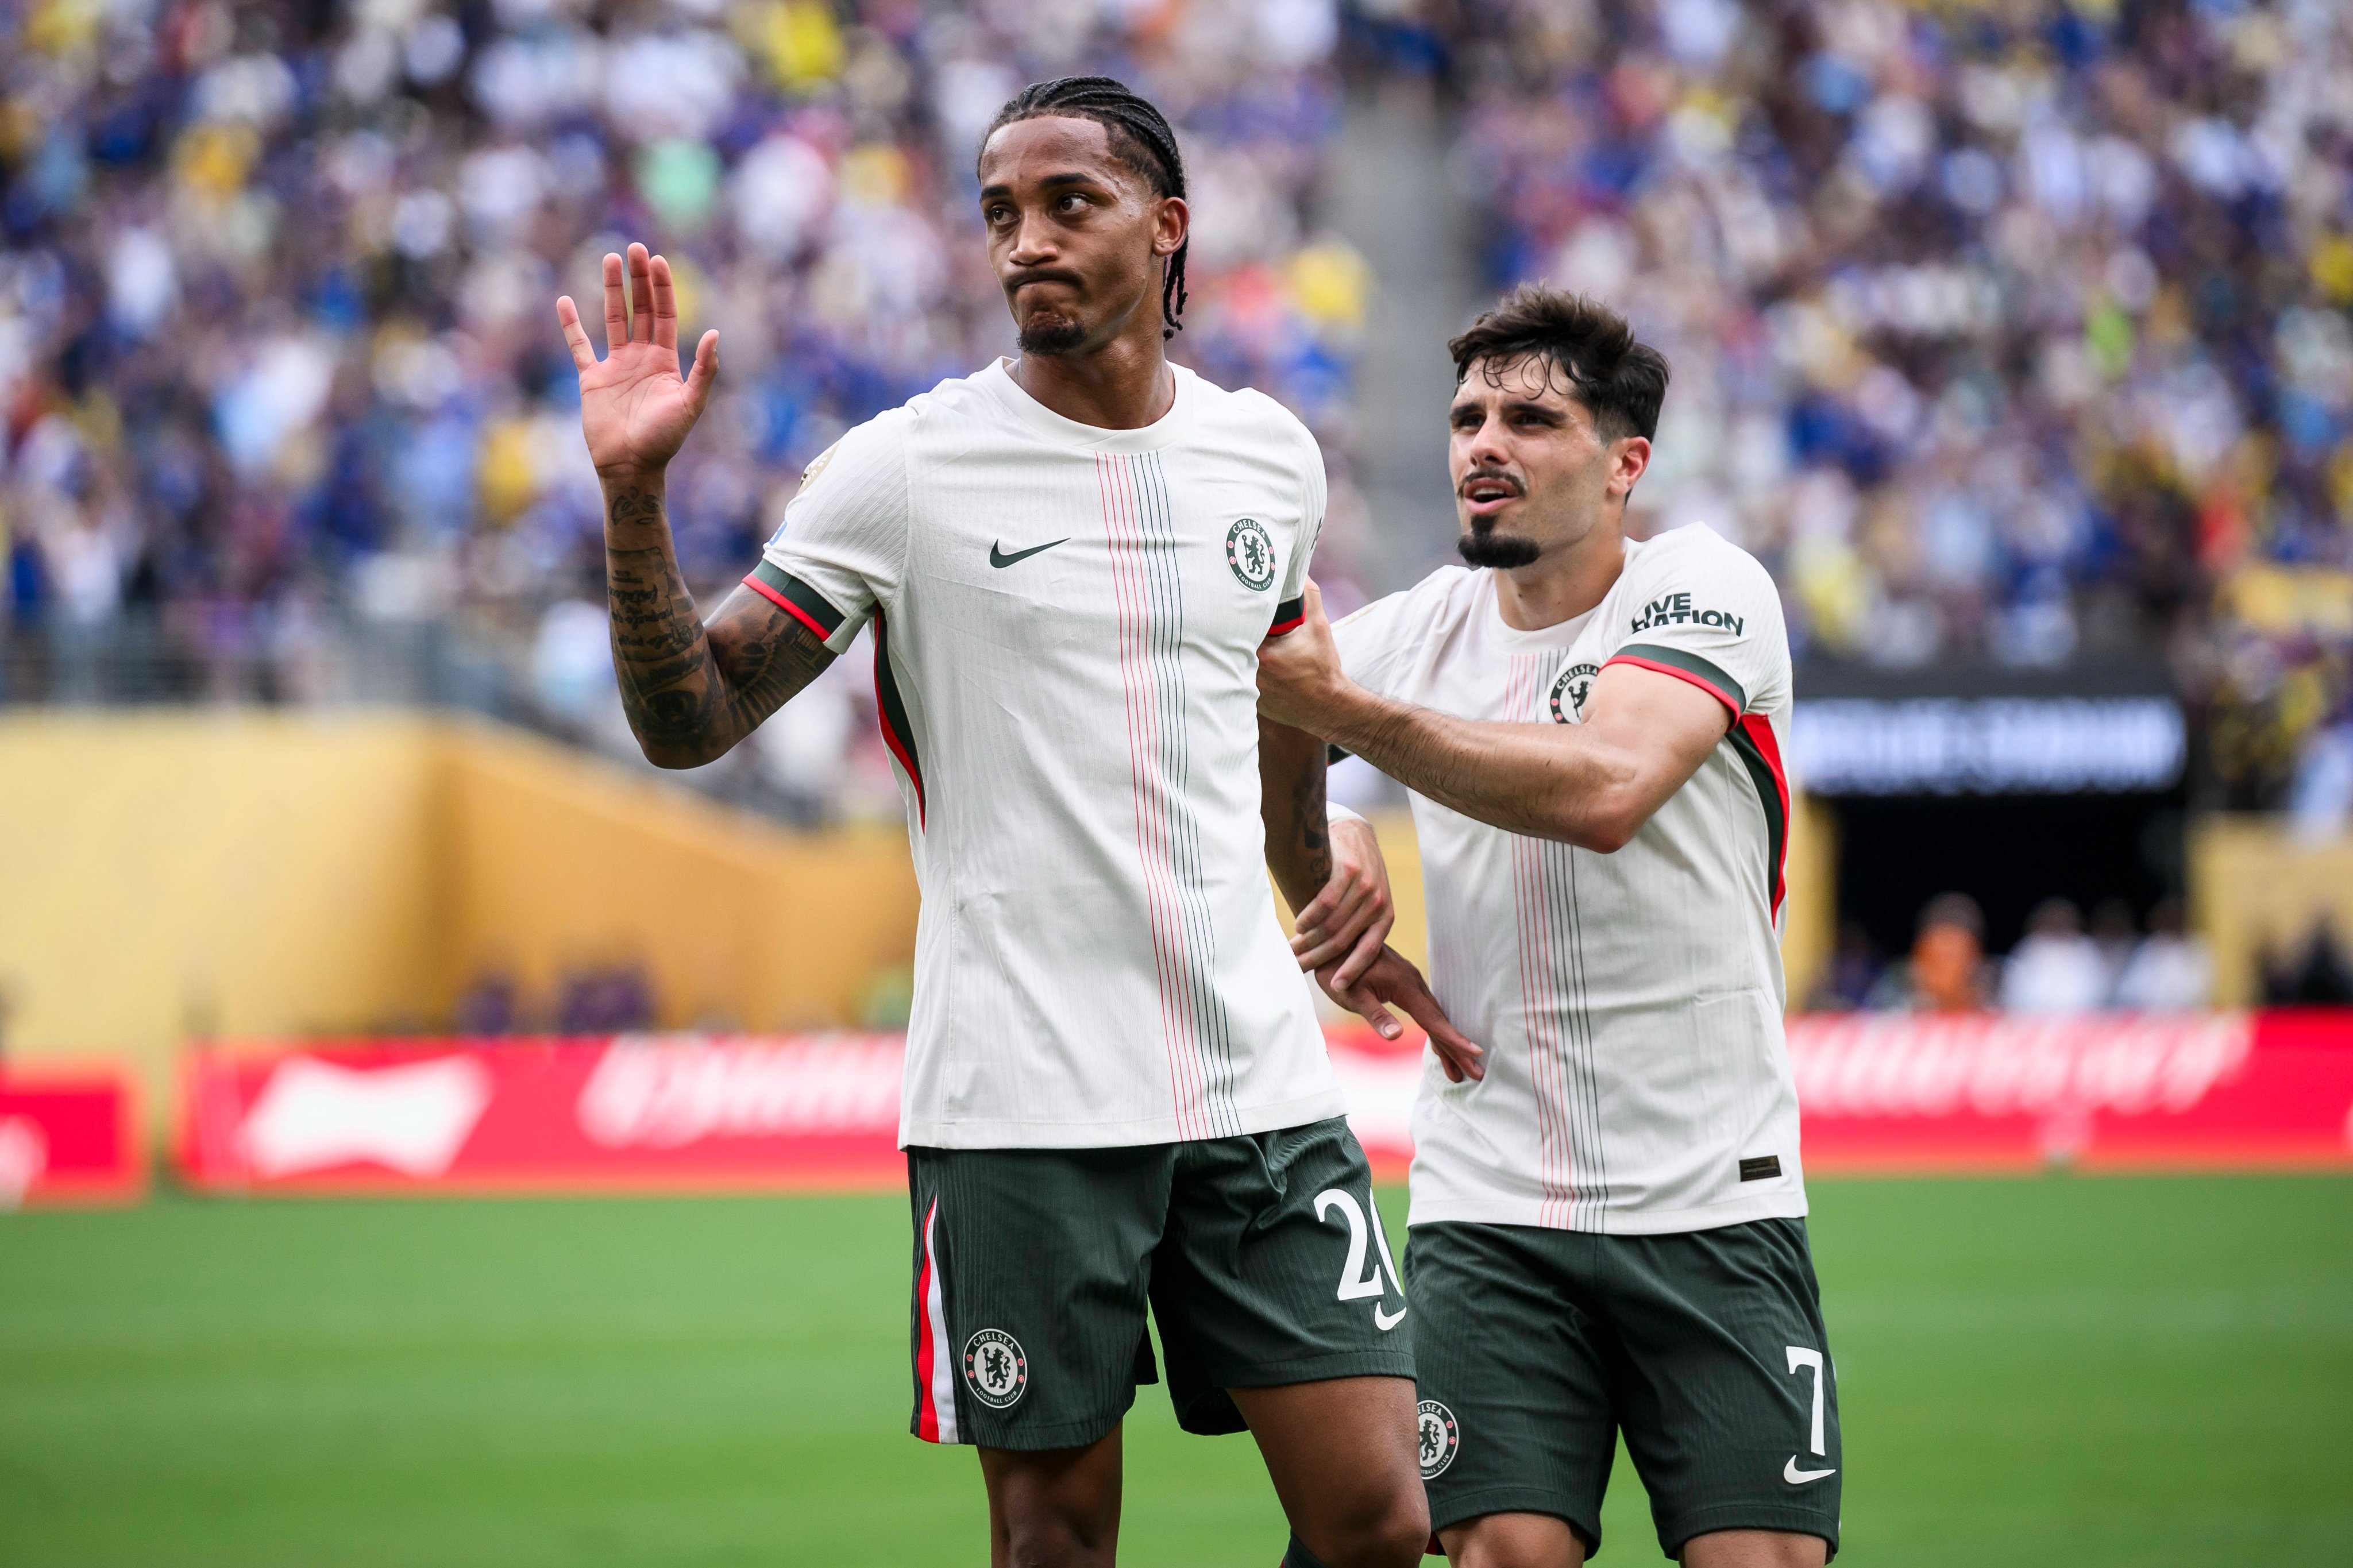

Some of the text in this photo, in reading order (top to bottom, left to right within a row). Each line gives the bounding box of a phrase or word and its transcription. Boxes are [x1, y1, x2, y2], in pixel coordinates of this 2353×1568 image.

[1233, 520, 1265, 538] CHELSEA
[1238, 573, 1271, 589] FOOTBALL CLUB
[1556, 665, 1598, 689] CHELSEA
[973, 1332, 1015, 1350] CHELSEA
[976, 1387, 1017, 1404] FOOTBALL CLUB
[1785, 1346, 1826, 1456] 7
[1417, 1403, 1442, 1416] ELSEA
